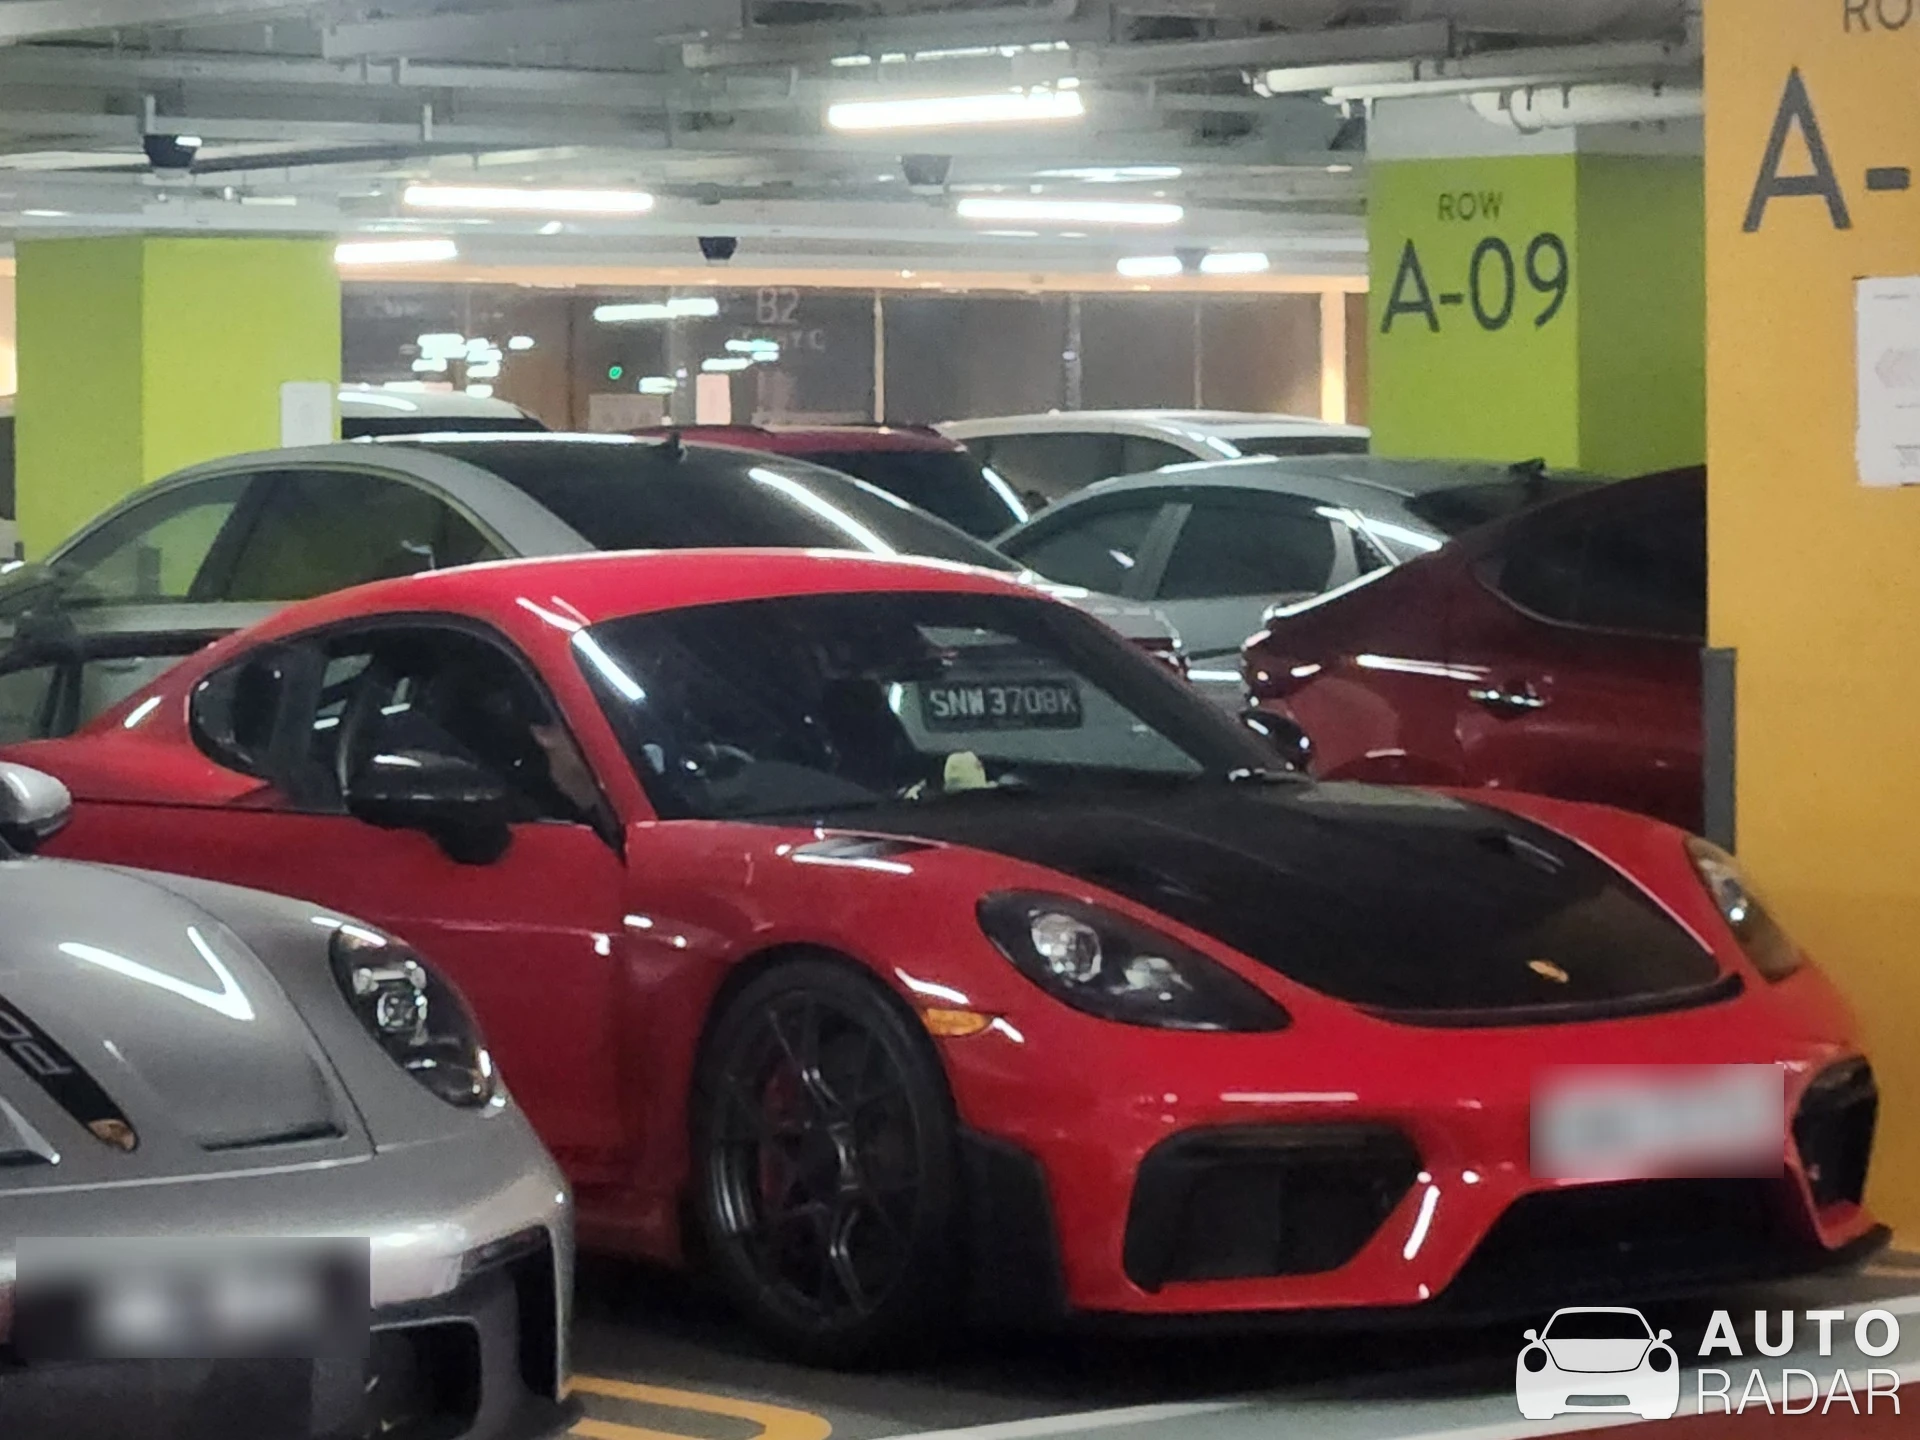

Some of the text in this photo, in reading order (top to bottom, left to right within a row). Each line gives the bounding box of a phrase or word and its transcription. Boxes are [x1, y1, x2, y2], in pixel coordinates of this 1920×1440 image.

[1437, 191, 1503, 222] ROW
[1380, 231, 1569, 334] A-09
[756, 287, 799, 324] B2
[988, 686, 1077, 715] 3708K
